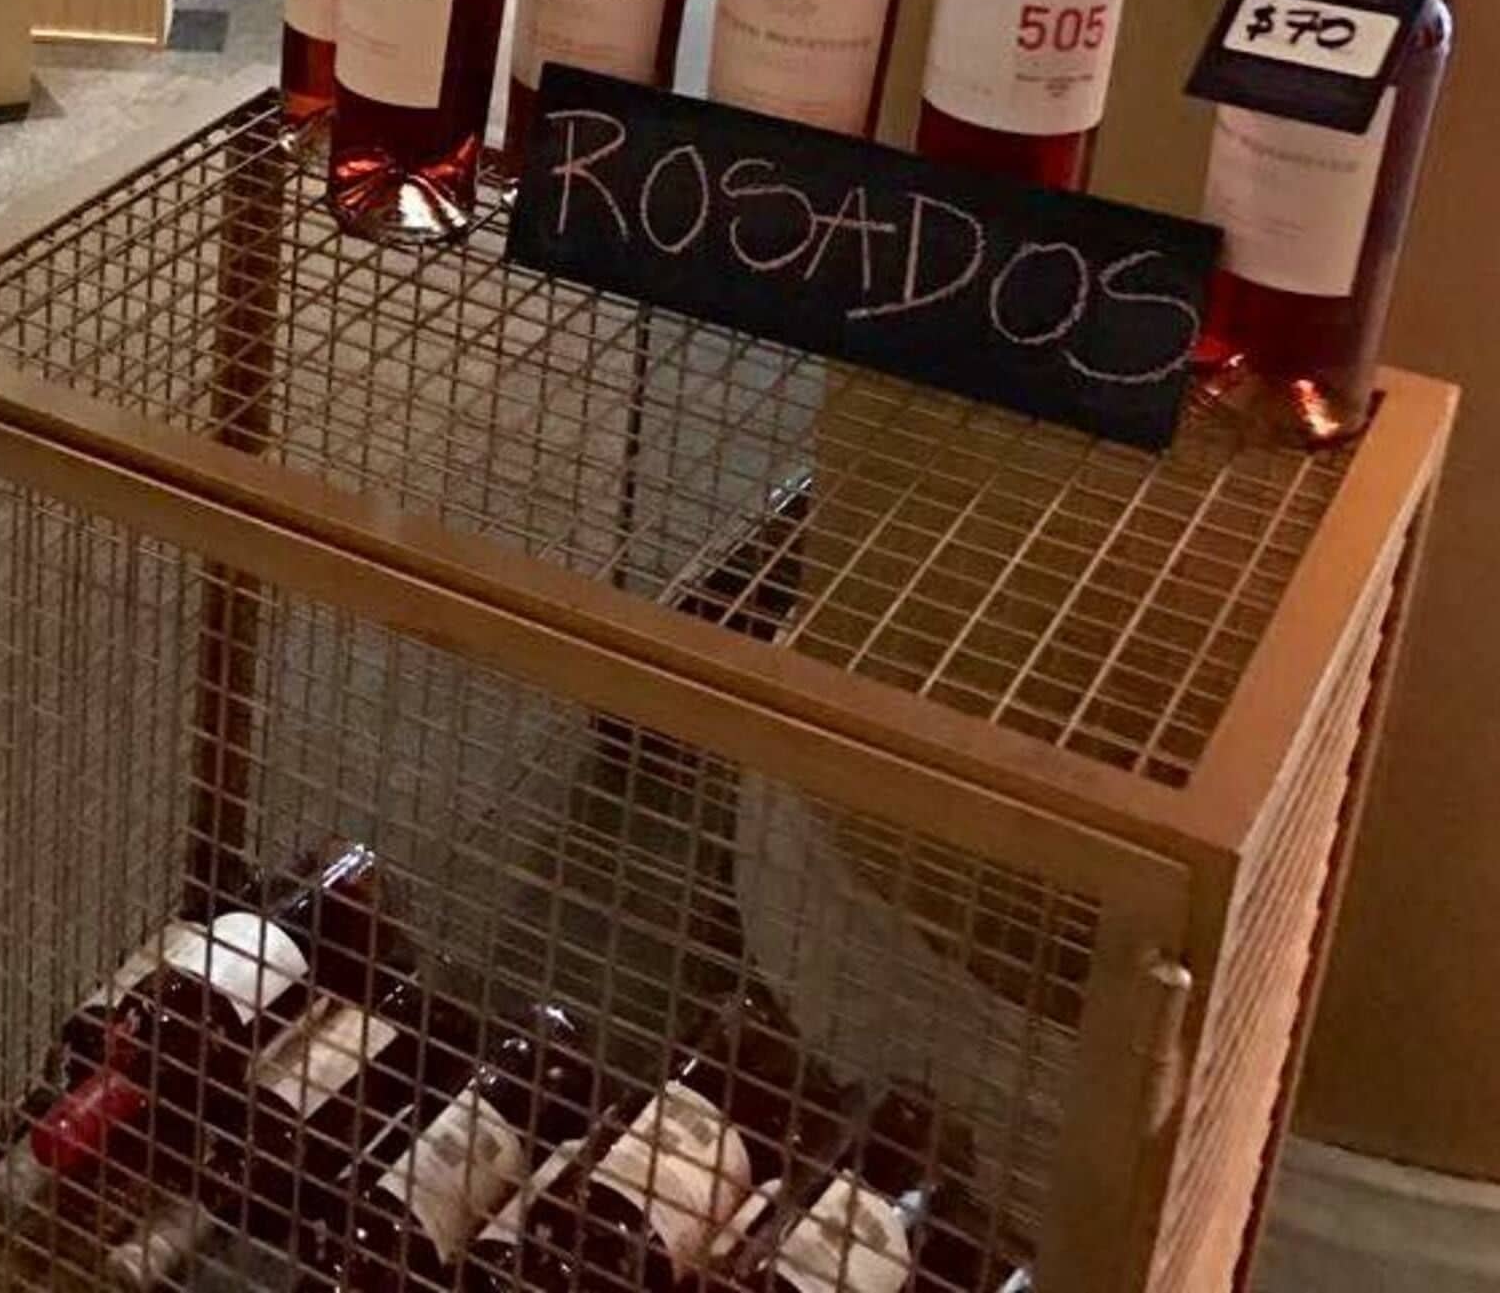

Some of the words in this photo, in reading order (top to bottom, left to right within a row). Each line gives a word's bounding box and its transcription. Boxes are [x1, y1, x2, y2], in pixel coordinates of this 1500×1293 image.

[1017, 5, 1107, 53] 505
[1245, 4, 1357, 49] $70
[545, 108, 1201, 385] ROSADOS
